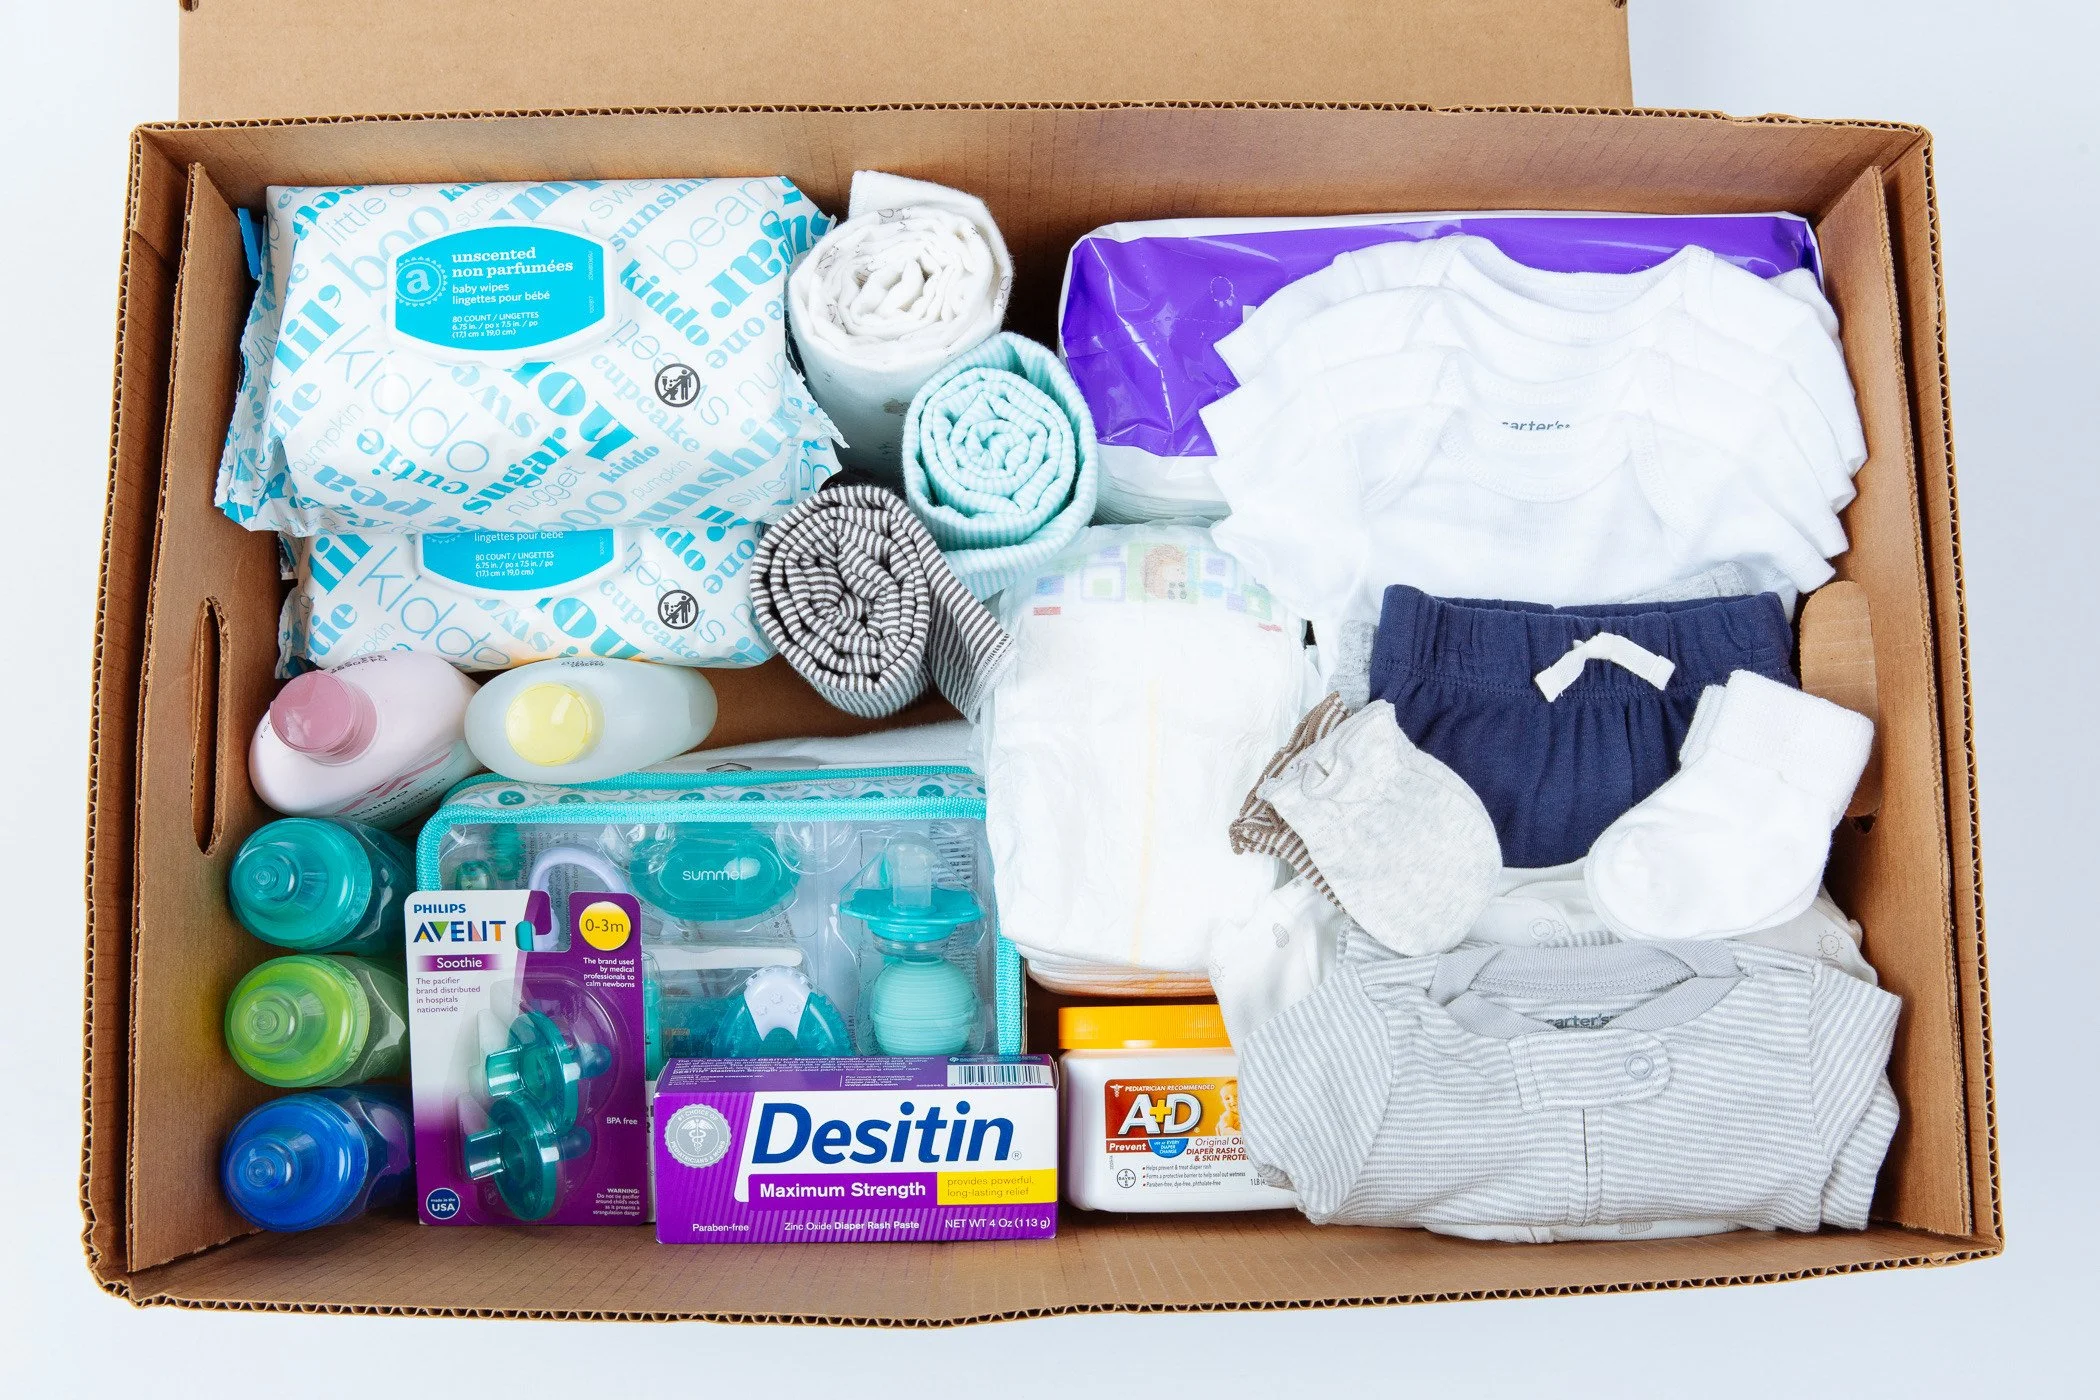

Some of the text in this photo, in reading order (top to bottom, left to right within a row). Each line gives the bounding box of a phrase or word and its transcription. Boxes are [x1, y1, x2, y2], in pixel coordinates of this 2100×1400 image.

[318, 197, 386, 247] little
[647, 178, 779, 275] bean
[321, 206, 449, 297] boo
[451, 246, 537, 264] unscented
[451, 266, 484, 279] non
[486, 259, 574, 279] parfumées
[406, 268, 432, 295] a
[452, 282, 510, 295] baby wipes
[452, 290, 551, 307] lingettes pour bébé
[619, 258, 710, 347] kiddo
[452, 311, 540, 323] 80 COUNT LINGETTES
[451, 319, 538, 331] 6.75 in. po 7.5 in. po
[500, 328, 517, 337] cm)
[705, 316, 766, 369] one
[590, 353, 701, 453] cupcake
[291, 402, 366, 476] pumpkin
[356, 427, 470, 495] cutie
[598, 446, 661, 484] kiddo
[463, 427, 572, 516] sugar
[631, 459, 692, 499] pumpkin
[505, 465, 587, 516] nugget
[474, 532, 539, 544] lingettes pour
[475, 551, 555, 562] 80 COUNT LINGETTES
[475, 559, 554, 570] 6.75 in. po 7.5 in. po
[703, 539, 756, 595] one
[520, 568, 534, 577] cm)
[598, 579, 700, 660] cupcake
[413, 902, 467, 914] PHILIPS
[412, 920, 507, 943] AVENT
[585, 918, 625, 933] 0-3m
[436, 956, 483, 969] Soothie
[583, 957, 635, 966] The brand used
[599, 965, 635, 975] by medical
[415, 976, 461, 987] The pacifier
[583, 973, 626, 982] professionals
[416, 985, 481, 995] brand distributed
[602, 980, 635, 989] newborns
[425, 996, 459, 1006] hospitals
[416, 1005, 459, 1014] nationwide
[684, 1109, 709, 1117] CHOICE
[1117, 1092, 1202, 1135] A+D
[606, 1117, 638, 1126] BPA free
[751, 1100, 1014, 1165] Desitin
[1108, 1142, 1147, 1151] Prevent
[1195, 1137, 1229, 1149] Original
[670, 1140, 709, 1163] PEDIATRICIANS
[1186, 1147, 1216, 1156] DIAPER
[1216, 1147, 1238, 1155] RASH
[1202, 1154, 1221, 1162] SKIN
[946, 1174, 1035, 1189] provides powerful,
[759, 1181, 926, 1200] Maximum Strength
[946, 1186, 1030, 1200] long-lasting relief
[431, 1203, 456, 1212] USA
[692, 1222, 749, 1233] Paraben-free
[784, 1219, 920, 1232] Zinc Oxide Diaper Rash Paste
[944, 1216, 1051, 1230] NET WT 4 Oz (113 g)
